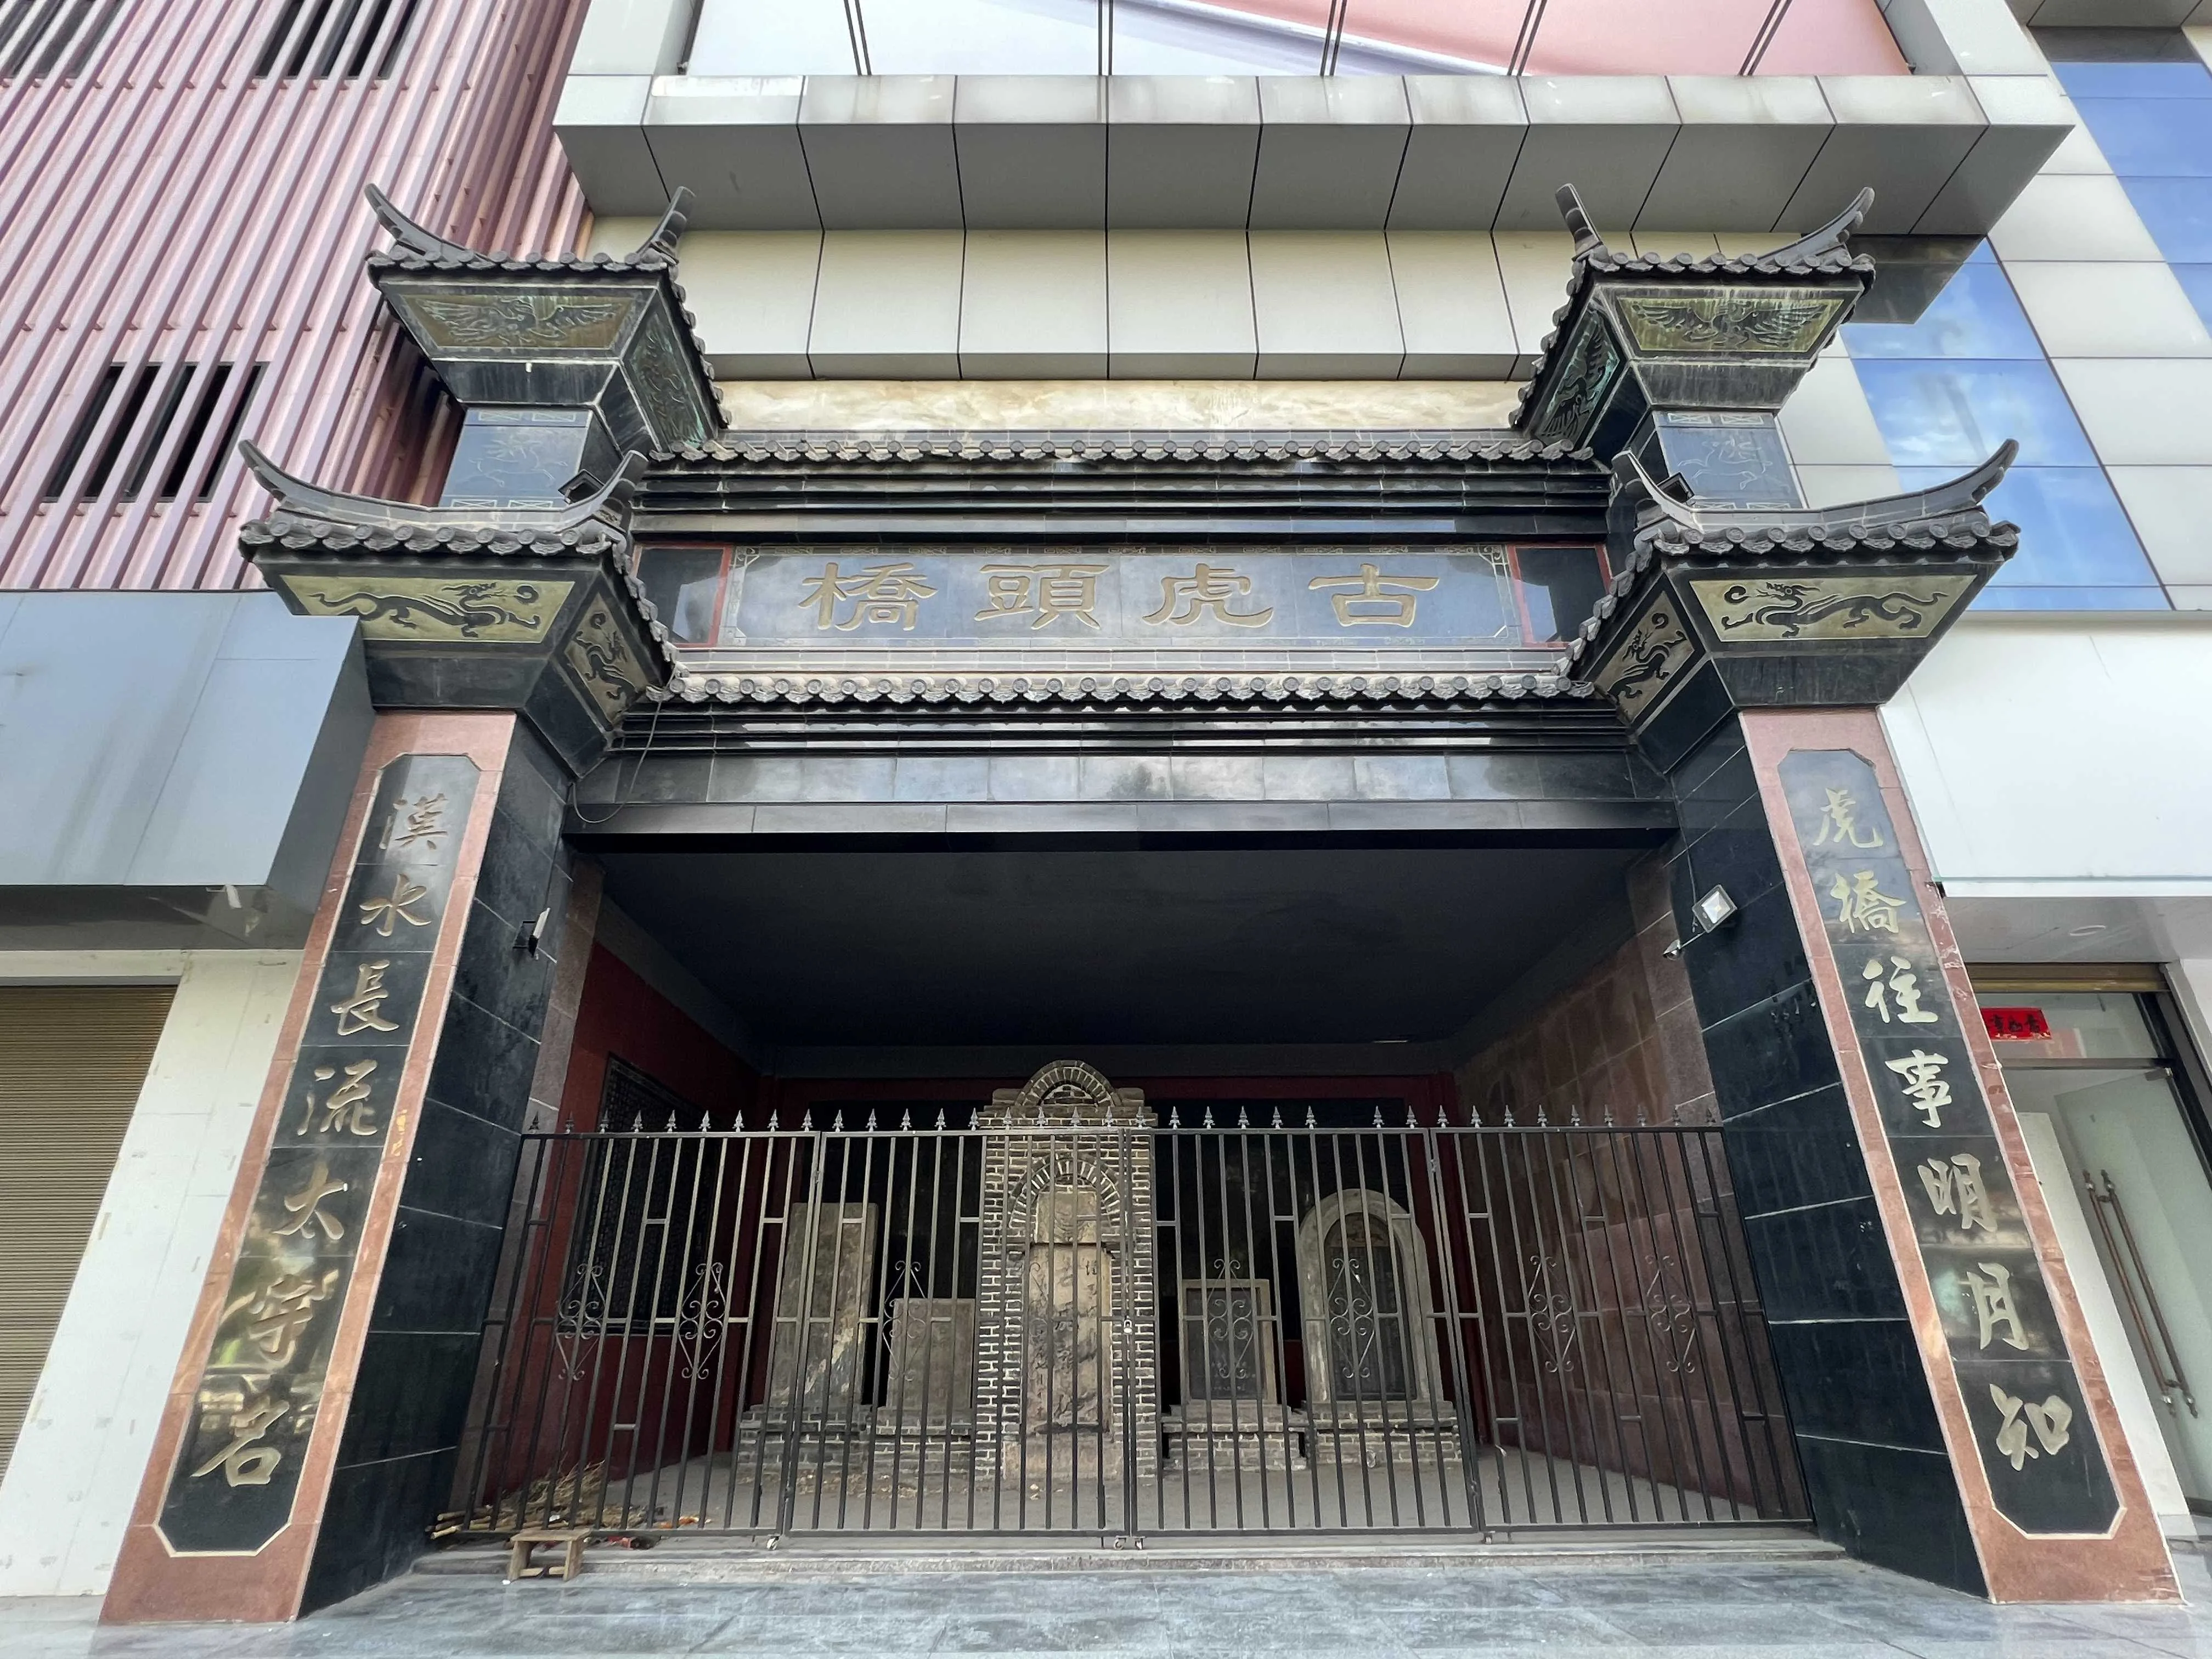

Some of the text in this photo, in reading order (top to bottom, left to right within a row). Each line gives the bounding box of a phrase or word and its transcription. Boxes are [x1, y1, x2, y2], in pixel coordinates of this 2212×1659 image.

[798, 562, 1440, 631] 古虎頭橋
[190, 793, 449, 1488] 漢水長流太守名
[1813, 788, 2073, 1472] 虎橋往事明月知
